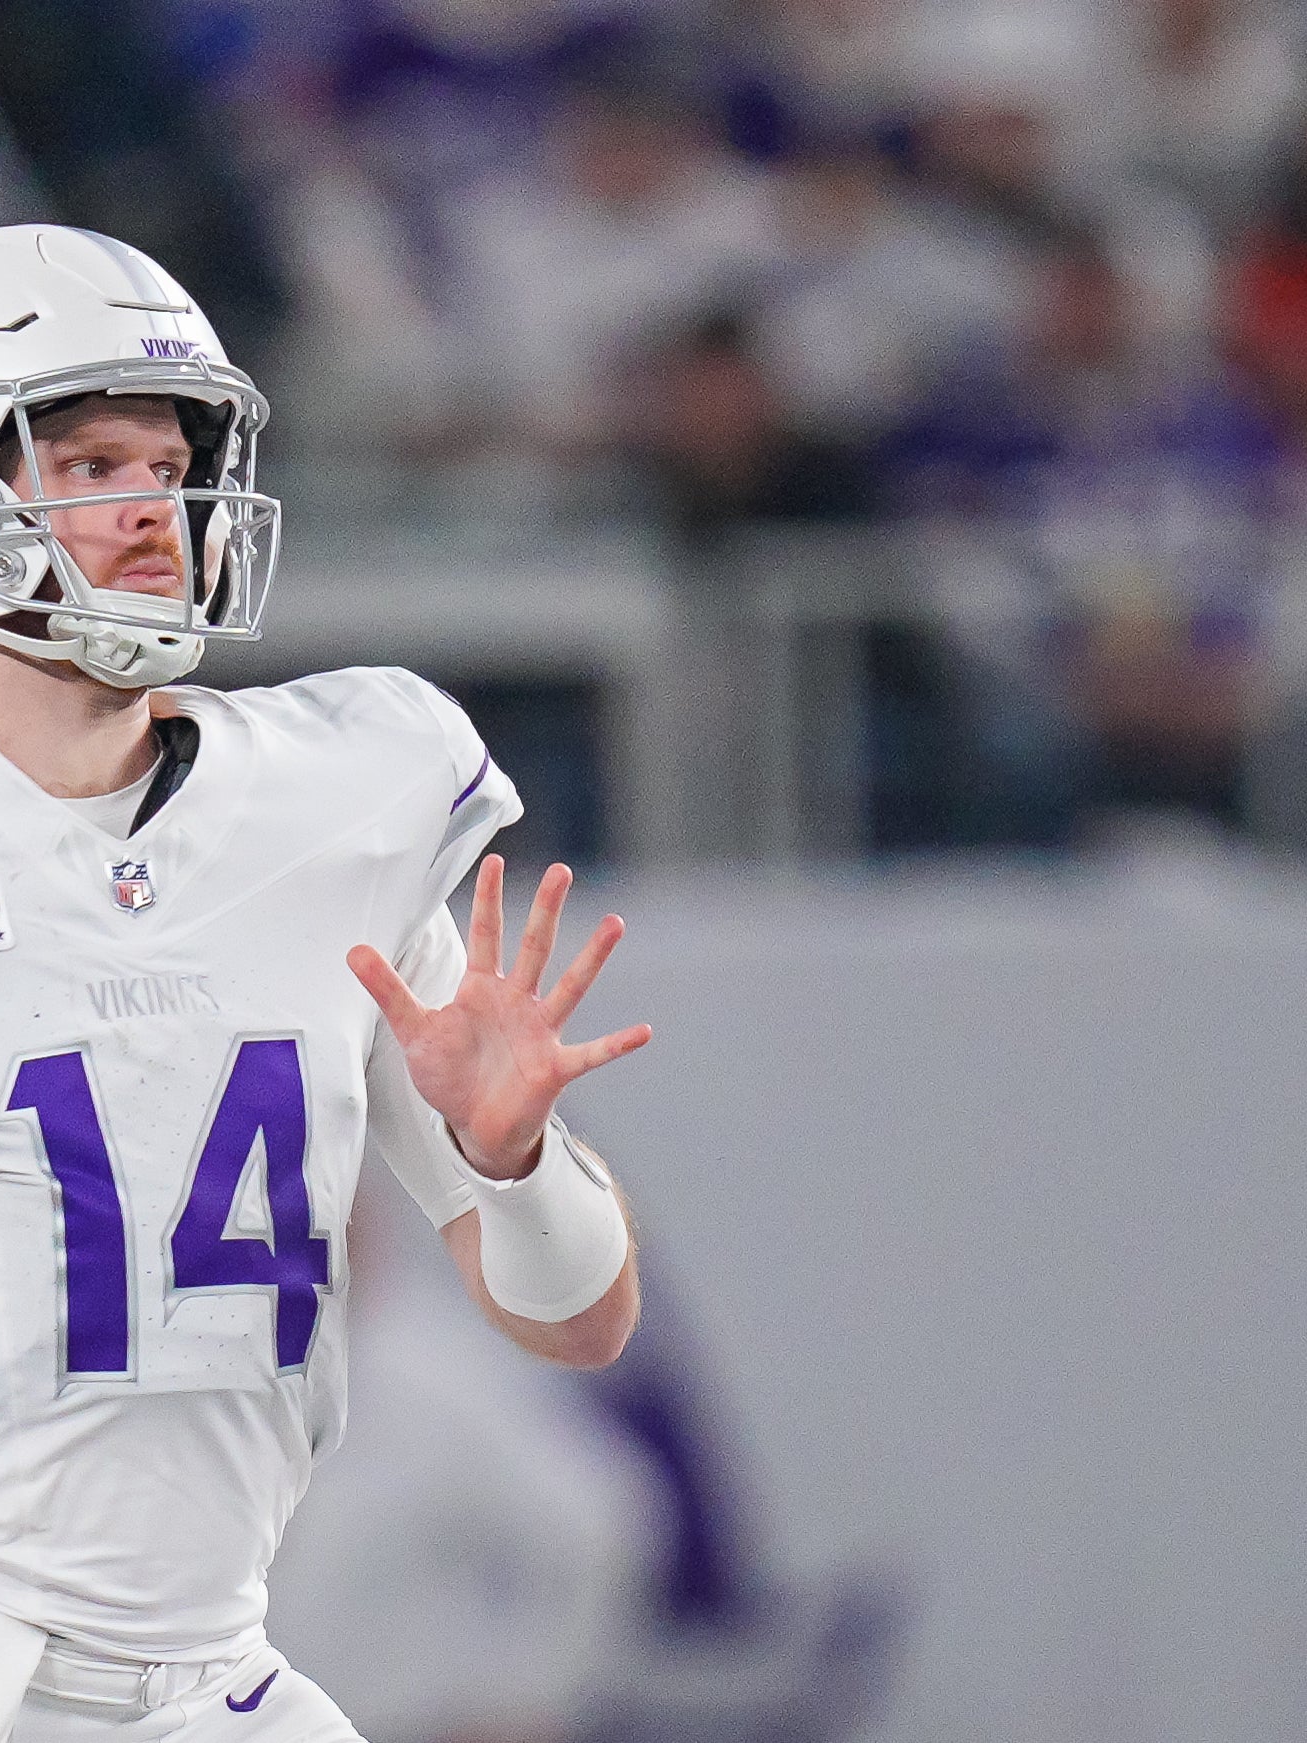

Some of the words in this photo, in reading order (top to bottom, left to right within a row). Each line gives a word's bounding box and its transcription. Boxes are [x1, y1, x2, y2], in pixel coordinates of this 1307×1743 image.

[140, 338, 209, 360] VIKIN
[85, 975, 220, 1020] VIKINGS
[0, 1036, 330, 1375] 14
